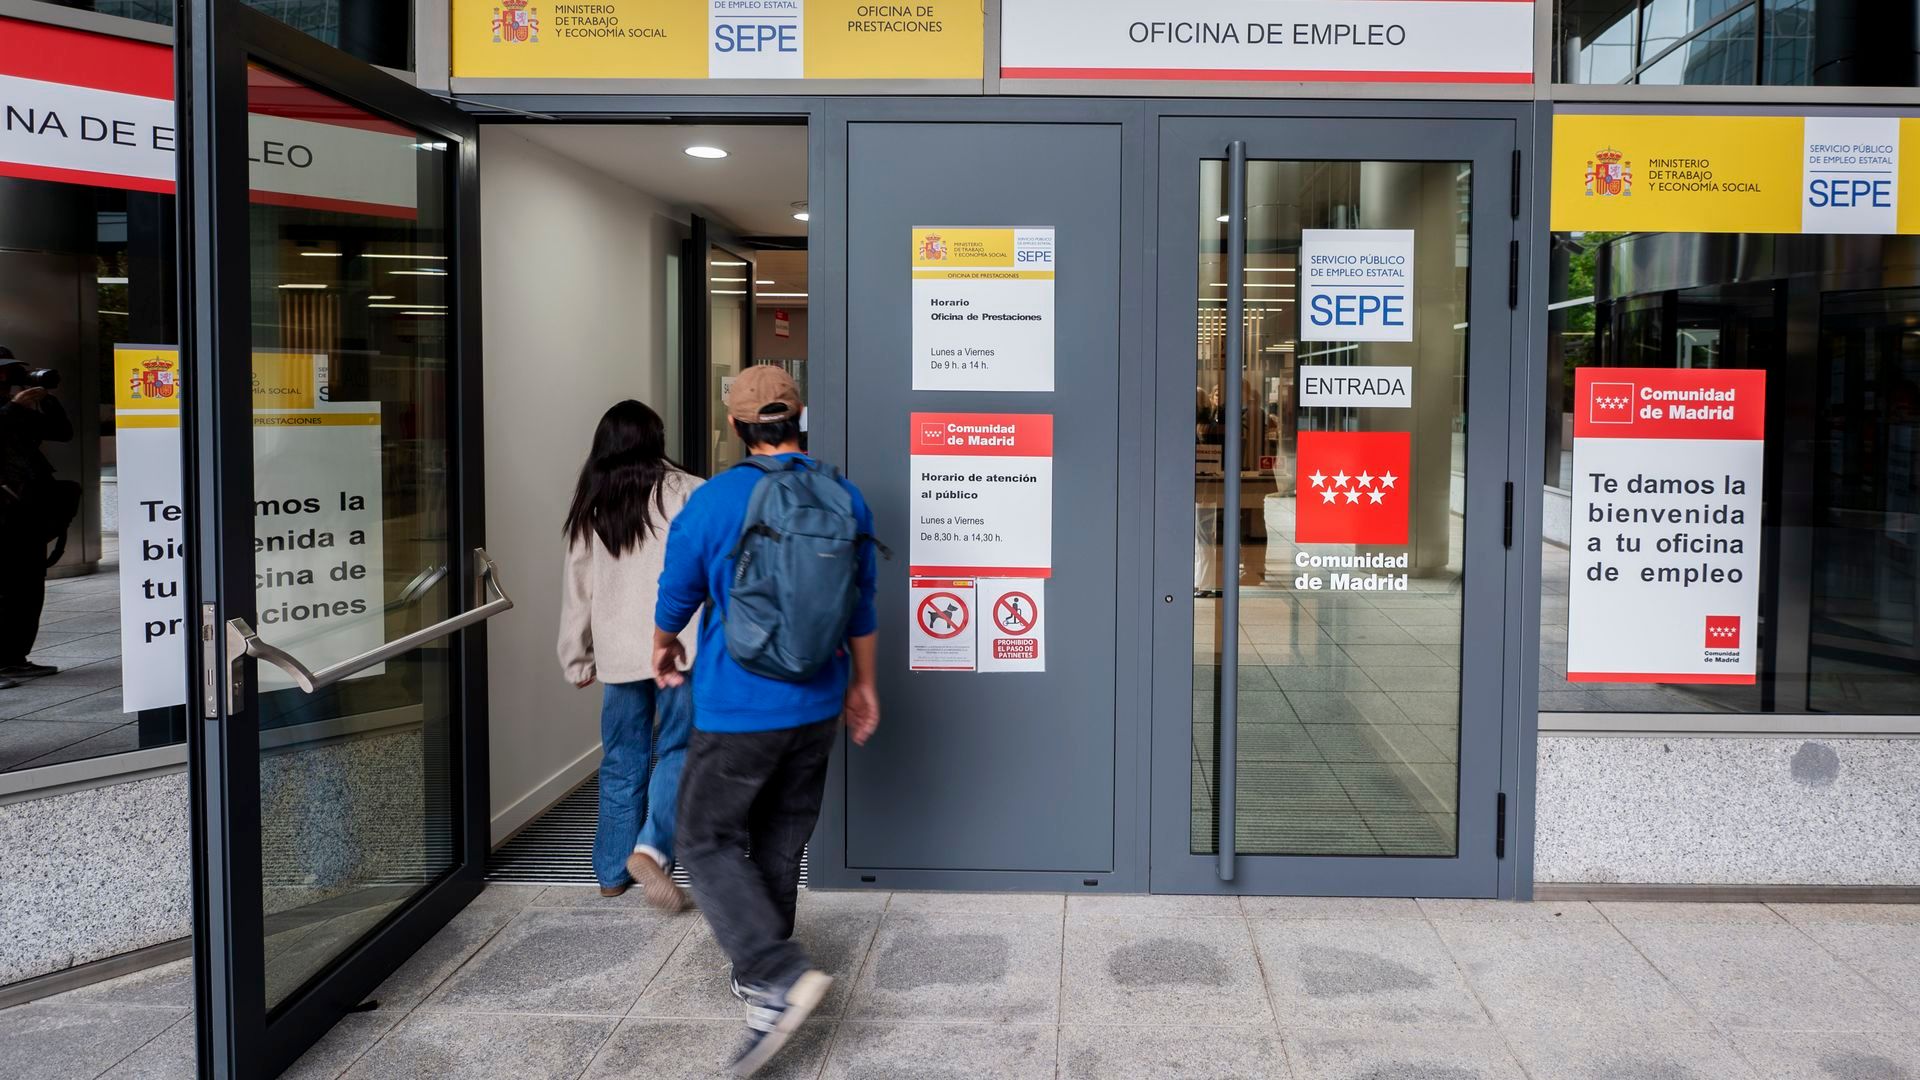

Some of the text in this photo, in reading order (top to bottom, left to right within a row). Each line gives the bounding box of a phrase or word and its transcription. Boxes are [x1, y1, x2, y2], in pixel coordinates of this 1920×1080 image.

[555, 5, 615, 14] MINISTERIO
[857, 6, 933, 17] OFICINA DE
[555, 17, 619, 28] DE TRABAJO
[848, 21, 943, 32] PRESTACIONES
[556, 27, 667, 38] Y ECONOMÍA SOCIAL
[715, 24, 797, 52] SEPE
[1129, 22, 1406, 46] OFICINA DE EMPLEO
[81, 116, 136, 147] DE
[1810, 144, 1893, 154] SERVICIO PÚBLICO
[1649, 159, 1709, 168] MINISTERIO
[1809, 156, 1893, 165] DE EMPLEO ESTATAL
[1649, 171, 1712, 182] DE TRABAJO
[1649, 181, 1761, 193] Y ECONOMÍA SOCIAL
[1809, 180, 1891, 207] SEPE
[1017, 251, 1052, 262] SEPE
[1310, 254, 1405, 265] SERVICIO PÚBLICO
[1310, 268, 1404, 277] DE EMPLEO ESTATAL
[1310, 295, 1404, 326] SEPE
[931, 313, 1042, 321] Oficina de Prestaciones
[931, 348, 955, 356] Lunes
[964, 348, 995, 356] Viernes
[931, 361, 942, 369] De
[945, 361, 949, 369] 9
[969, 361, 979, 369] 14
[1306, 378, 1405, 396] ENTRADA
[1640, 387, 1735, 402] Comunidad
[1640, 405, 1734, 421] de Madrid
[254, 417, 322, 425] PRESTACIONES
[947, 424, 1015, 434] Comunidad
[947, 436, 1015, 446] de Madrid
[921, 473, 1037, 483] Horario de atención
[1589, 474, 1746, 495] Te damos la
[921, 491, 978, 500] al público
[140, 500, 182, 522] Te
[340, 492, 365, 511] la
[1589, 503, 1745, 524] bienvenida
[920, 516, 945, 524] Lunes
[954, 516, 984, 525] Viernes
[349, 530, 365, 545] a
[921, 533, 932, 541] De
[934, 533, 952, 542] 8,30
[953, 533, 961, 542] h.
[972, 534, 993, 543] 14,30
[995, 534, 1003, 542] h.
[1587, 533, 1744, 554] a tu oficina
[1295, 552, 1408, 568] Comunidad
[142, 578, 177, 599] tu
[330, 561, 366, 582] de
[1586, 562, 1743, 587] de empleo
[1295, 573, 1408, 591] de Madrid
